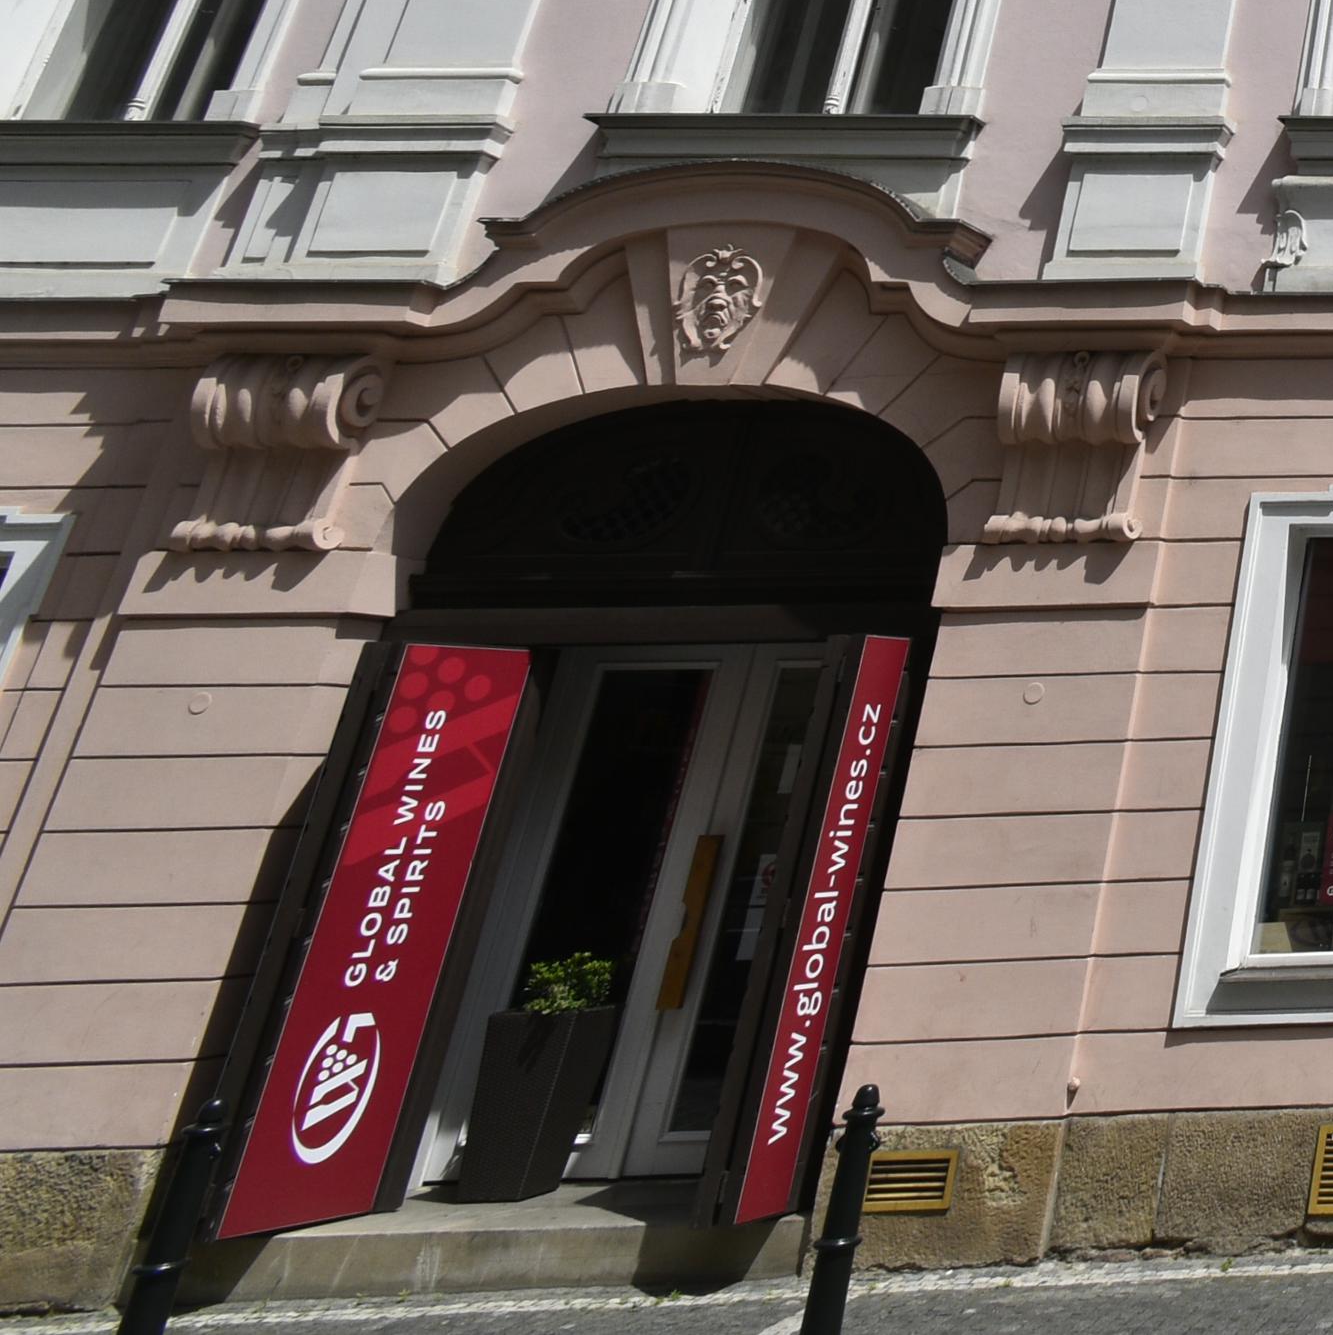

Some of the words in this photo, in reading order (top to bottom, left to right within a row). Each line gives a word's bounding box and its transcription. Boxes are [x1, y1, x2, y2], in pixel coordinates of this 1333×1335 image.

[344, 836, 408, 987] GLOBAL
[393, 709, 447, 826] WINES
[374, 958, 398, 983] &
[386, 799, 446, 946] SPIRITS
[767, 702, 882, 1146] www.global-wines.cz
